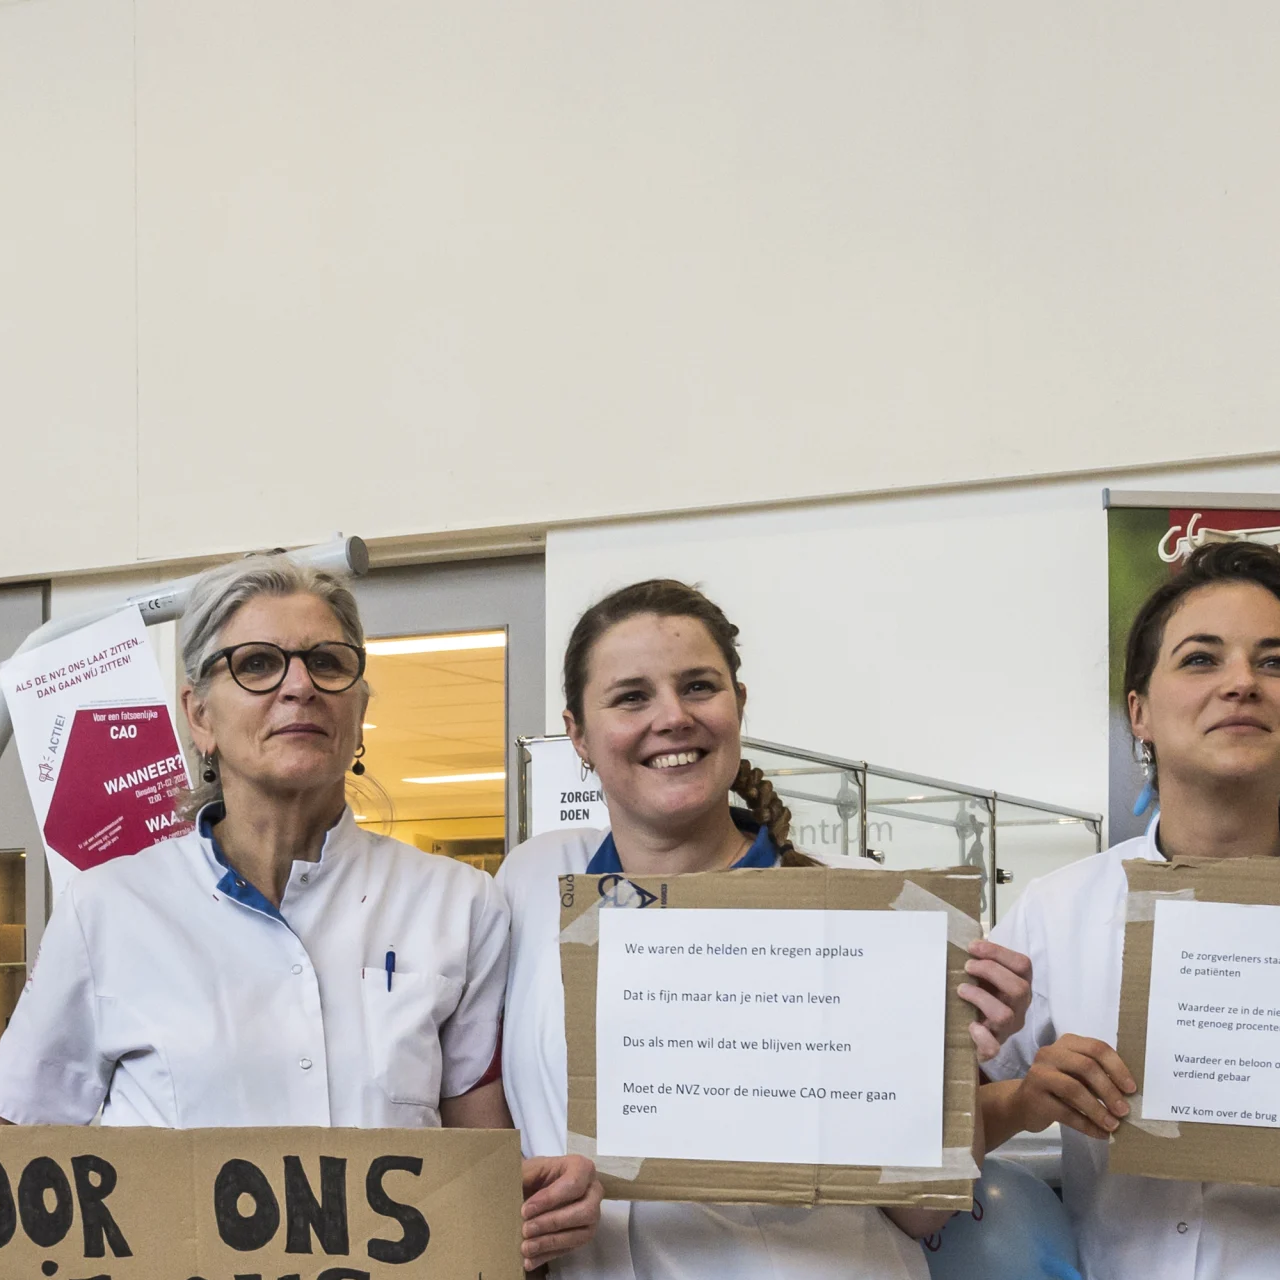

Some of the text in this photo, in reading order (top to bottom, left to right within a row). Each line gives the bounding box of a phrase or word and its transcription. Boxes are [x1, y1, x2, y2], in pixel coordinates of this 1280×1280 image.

[16, 680, 33, 693] ALS
[34, 675, 47, 686] DE
[49, 667, 67, 681] NVZ
[69, 660, 86, 673] ONS
[87, 650, 108, 666] LAAT
[37, 685, 56, 699] DAN
[58, 675, 82, 691] GAAN
[100, 654, 132, 674] ZITTEN!
[93, 713, 106, 722] Voor
[121, 710, 158, 722] fatsoenlijke
[48, 714, 66, 754] ACTIE!
[110, 724, 137, 739] CAO
[104, 754, 183, 795] WANNEER?
[560, 791, 604, 803] ZORGEN
[560, 809, 590, 821] DOEN
[625, 943, 864, 959] We waren de helden en kregen applaus
[1181, 951, 1194, 960] De
[1196, 953, 1261, 964] zorgverleners
[1180, 966, 1241, 977] de patiënten
[623, 989, 840, 1005] Dat is fijn maar kan je niet van leven
[1178, 1002, 1225, 1013] Waardeer
[1228, 1006, 1239, 1015] ze
[1241, 1005, 1250, 1015] in
[1253, 1006, 1264, 1016] de
[1176, 1018, 1195, 1027] met
[1198, 1020, 1233, 1031] genoeg
[623, 1036, 851, 1052] Dus als men wil dat we blijven werken
[1174, 1054, 1221, 1065] Waardeer
[1224, 1058, 1236, 1066] en
[1239, 1058, 1272, 1068] beloon
[1173, 1069, 1251, 1082] verdiend gebaar
[623, 1082, 896, 1103] Moet de NVZ voor de nieuwe CAO meer gaan
[623, 1104, 657, 1115] geven
[1171, 1105, 1190, 1115] NVZ
[1193, 1107, 1214, 1117] kom
[1216, 1110, 1238, 1118] over
[1240, 1110, 1252, 1119] de
[1255, 1111, 1277, 1122] brug
[214, 1155, 431, 1264] ONS
